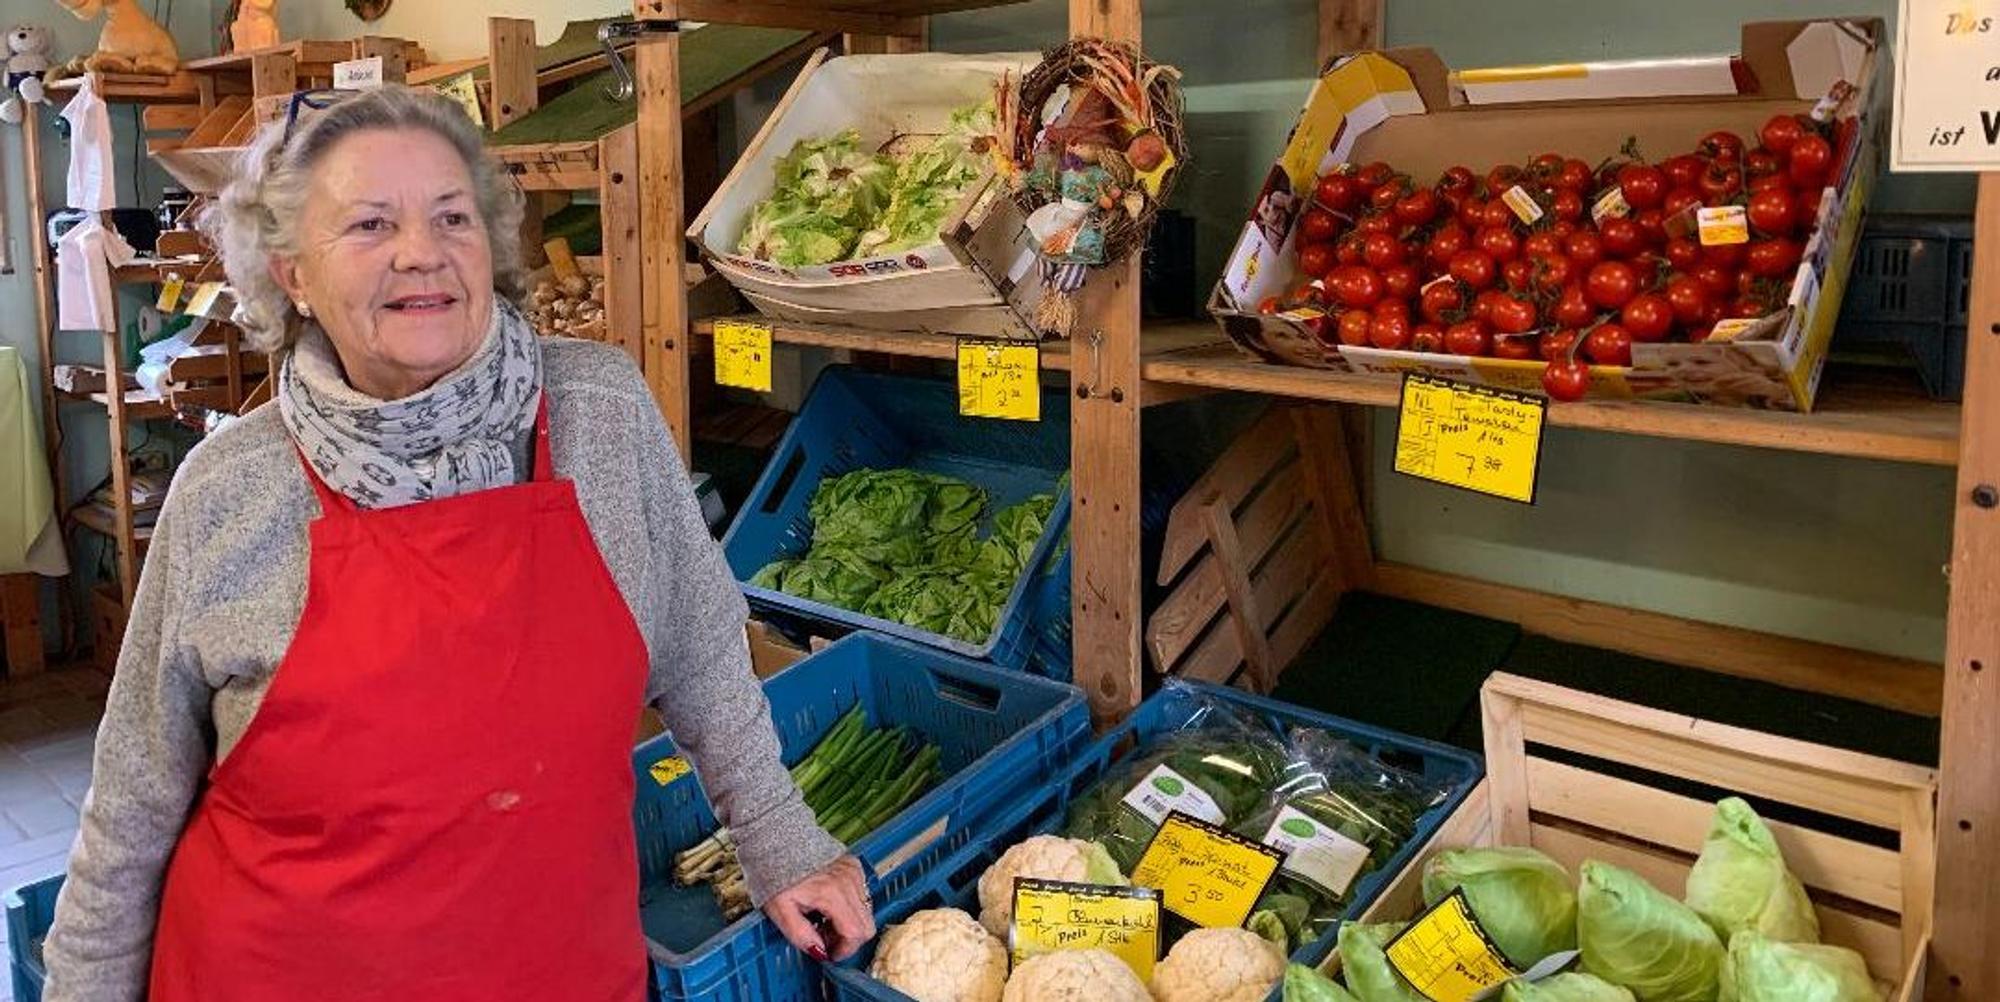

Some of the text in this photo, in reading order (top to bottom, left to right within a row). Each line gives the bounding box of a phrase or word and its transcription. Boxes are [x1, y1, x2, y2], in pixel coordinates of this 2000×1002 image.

[1929, 126, 1965, 146] ist
[1440, 424, 1469, 433] Preis
[1455, 452, 1476, 479] 7
[1184, 883, 1202, 904] 3
[1058, 928, 1088, 944] Preis
